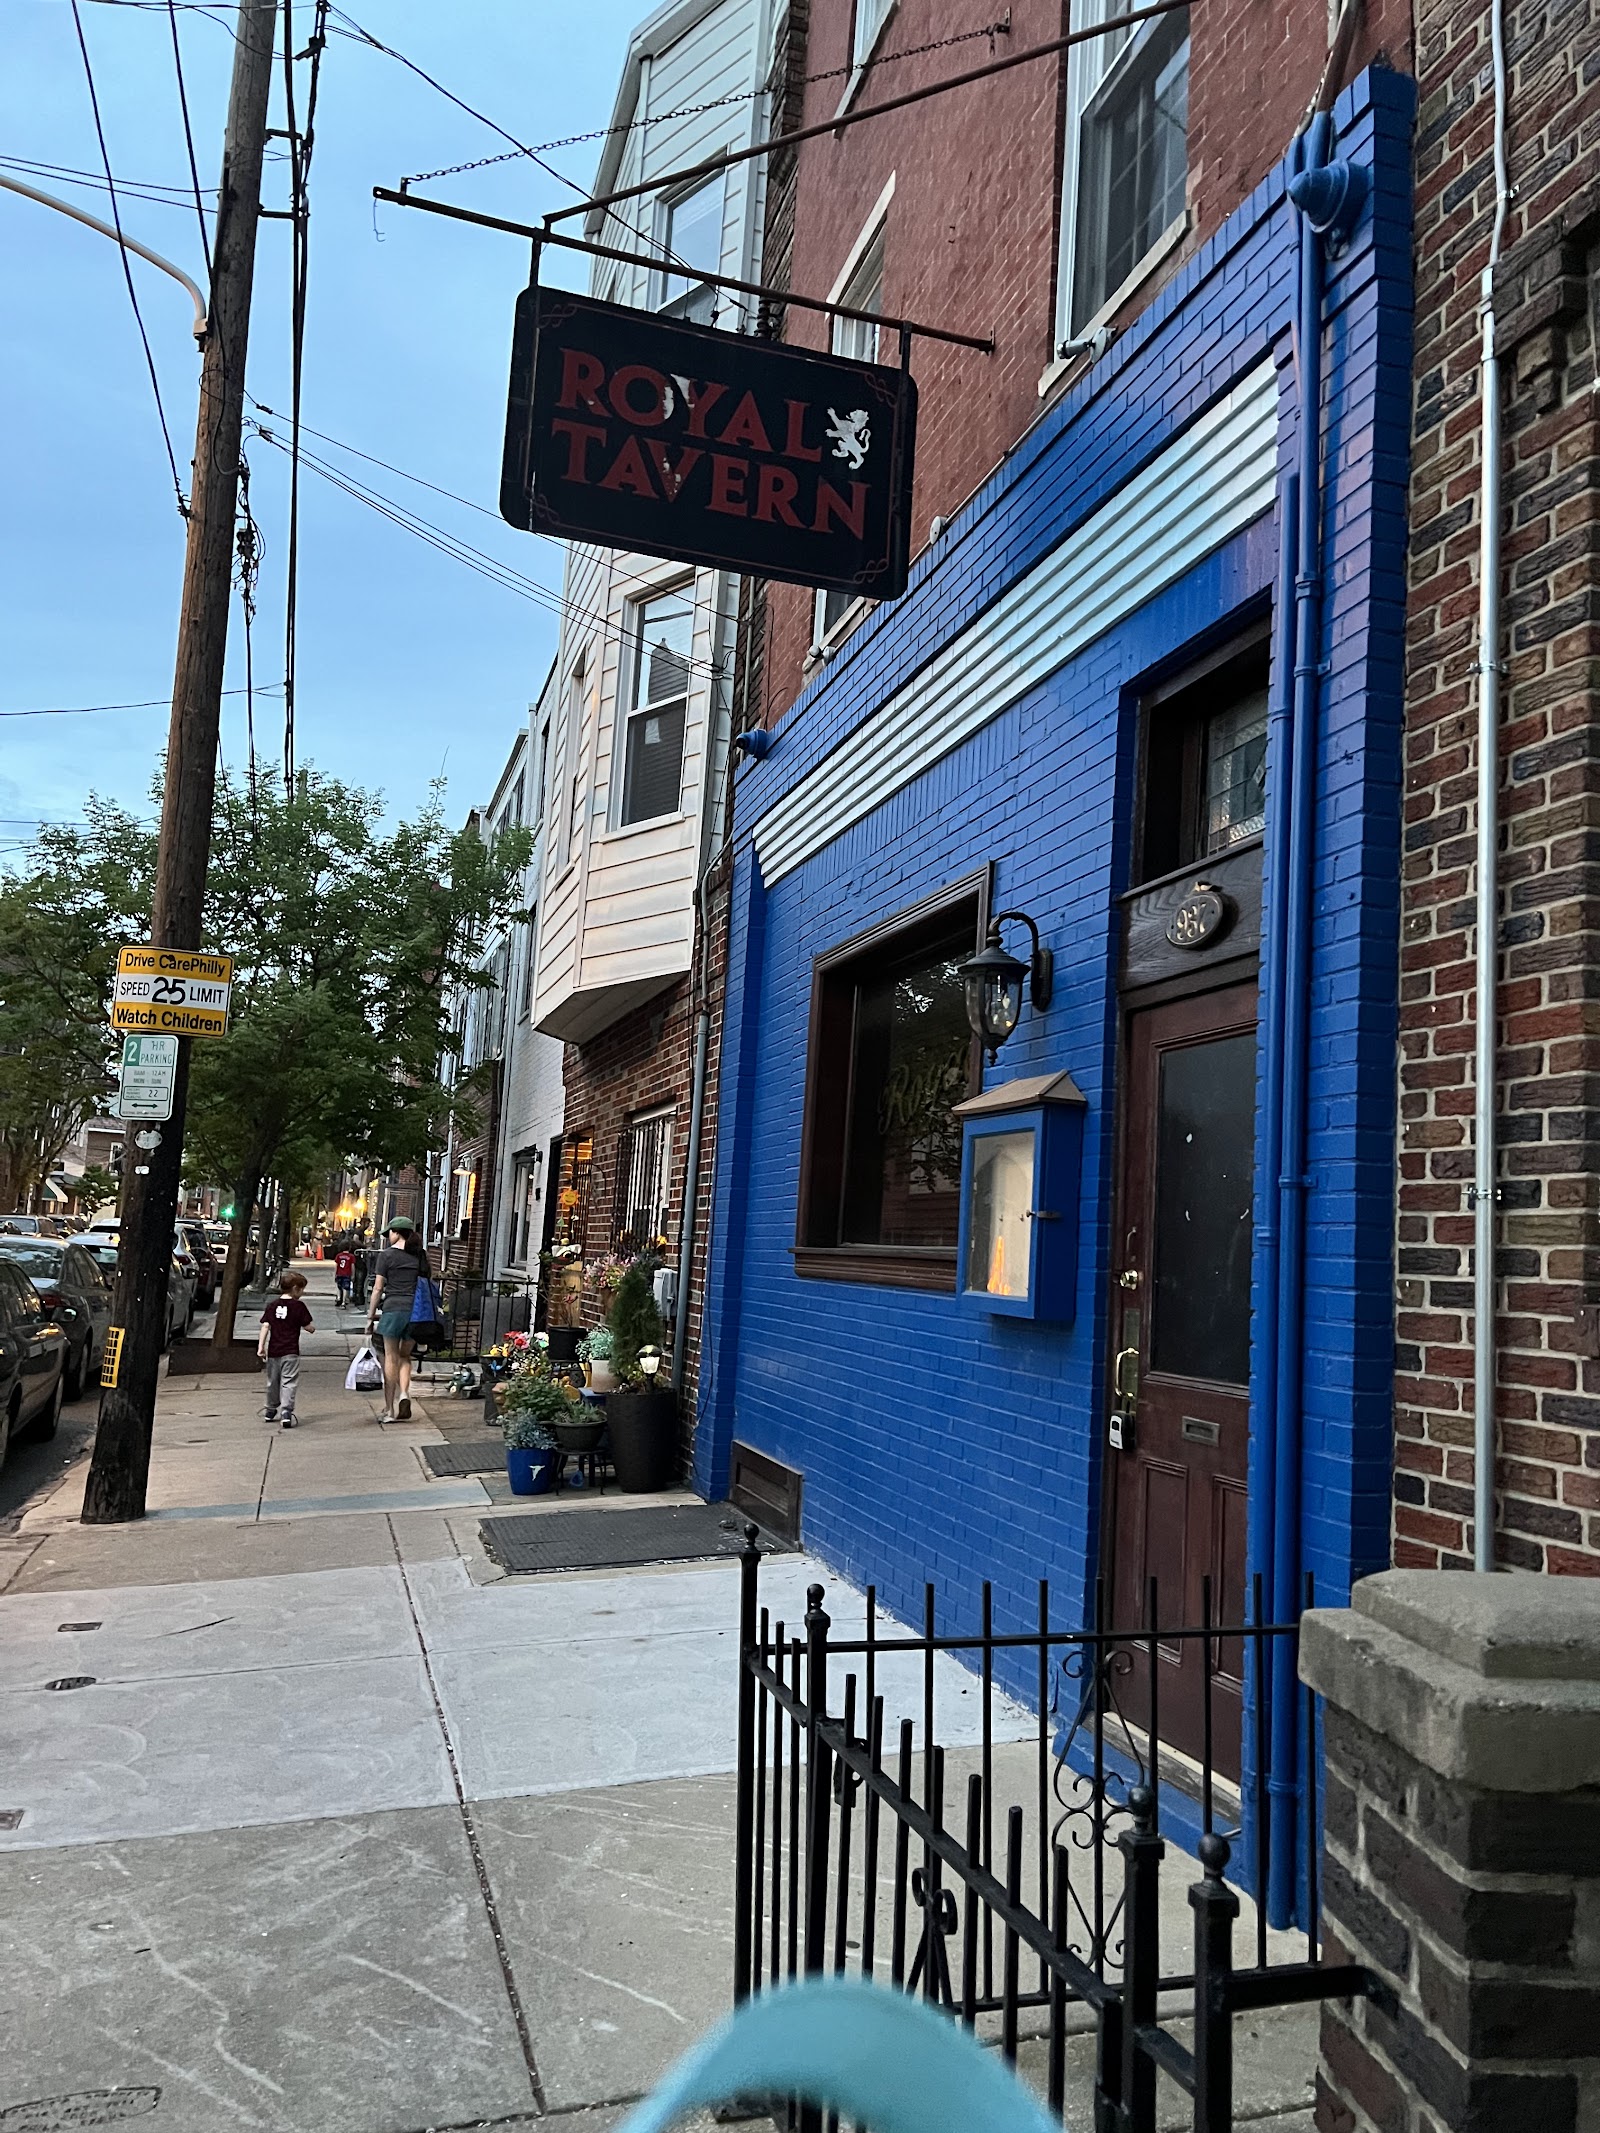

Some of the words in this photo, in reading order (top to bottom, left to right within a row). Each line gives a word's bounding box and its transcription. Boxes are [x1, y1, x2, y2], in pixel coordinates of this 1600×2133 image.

[555, 347, 823, 464] ROYAL
[552, 418, 872, 540] TAVERN
[1177, 903, 1206, 940] 937
[125, 952, 155, 968] Drive
[159, 954, 226, 977] CarePhilly
[120, 981, 150, 997] SPEED
[151, 976, 187, 1005] 25
[189, 986, 225, 1004] LIMIT
[116, 1008, 157, 1025] Watch
[161, 1011, 222, 1032] Children
[127, 1040, 138, 1062] 2
[151, 1040, 166, 1051] HR
[140, 1053, 173, 1065] PARKING
[340, 1259, 346, 1268] 3
